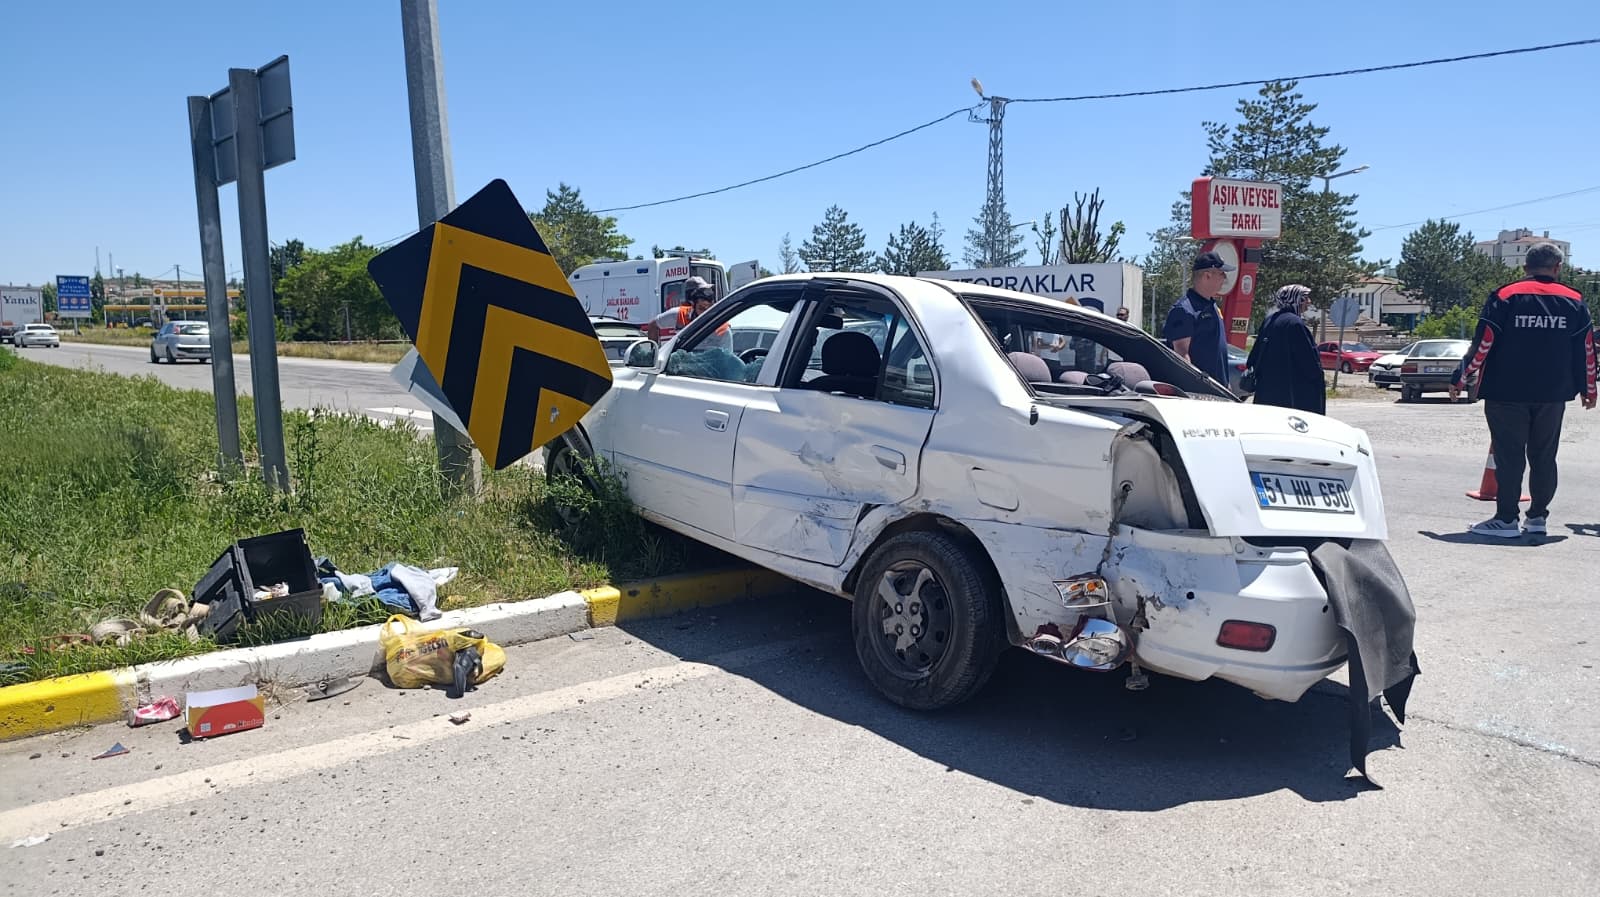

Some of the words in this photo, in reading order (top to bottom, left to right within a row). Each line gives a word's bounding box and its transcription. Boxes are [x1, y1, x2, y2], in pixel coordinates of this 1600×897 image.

[1213, 185, 1238, 211] AŞIK
[1241, 187, 1279, 209] VEYSEL
[1231, 213, 1261, 230] PARKI
[665, 266, 689, 278] AMBU
[617, 306, 629, 320] 112
[1262, 477, 1287, 504] 51
[1290, 479, 1316, 506] HH
[1319, 481, 1350, 508] 650
